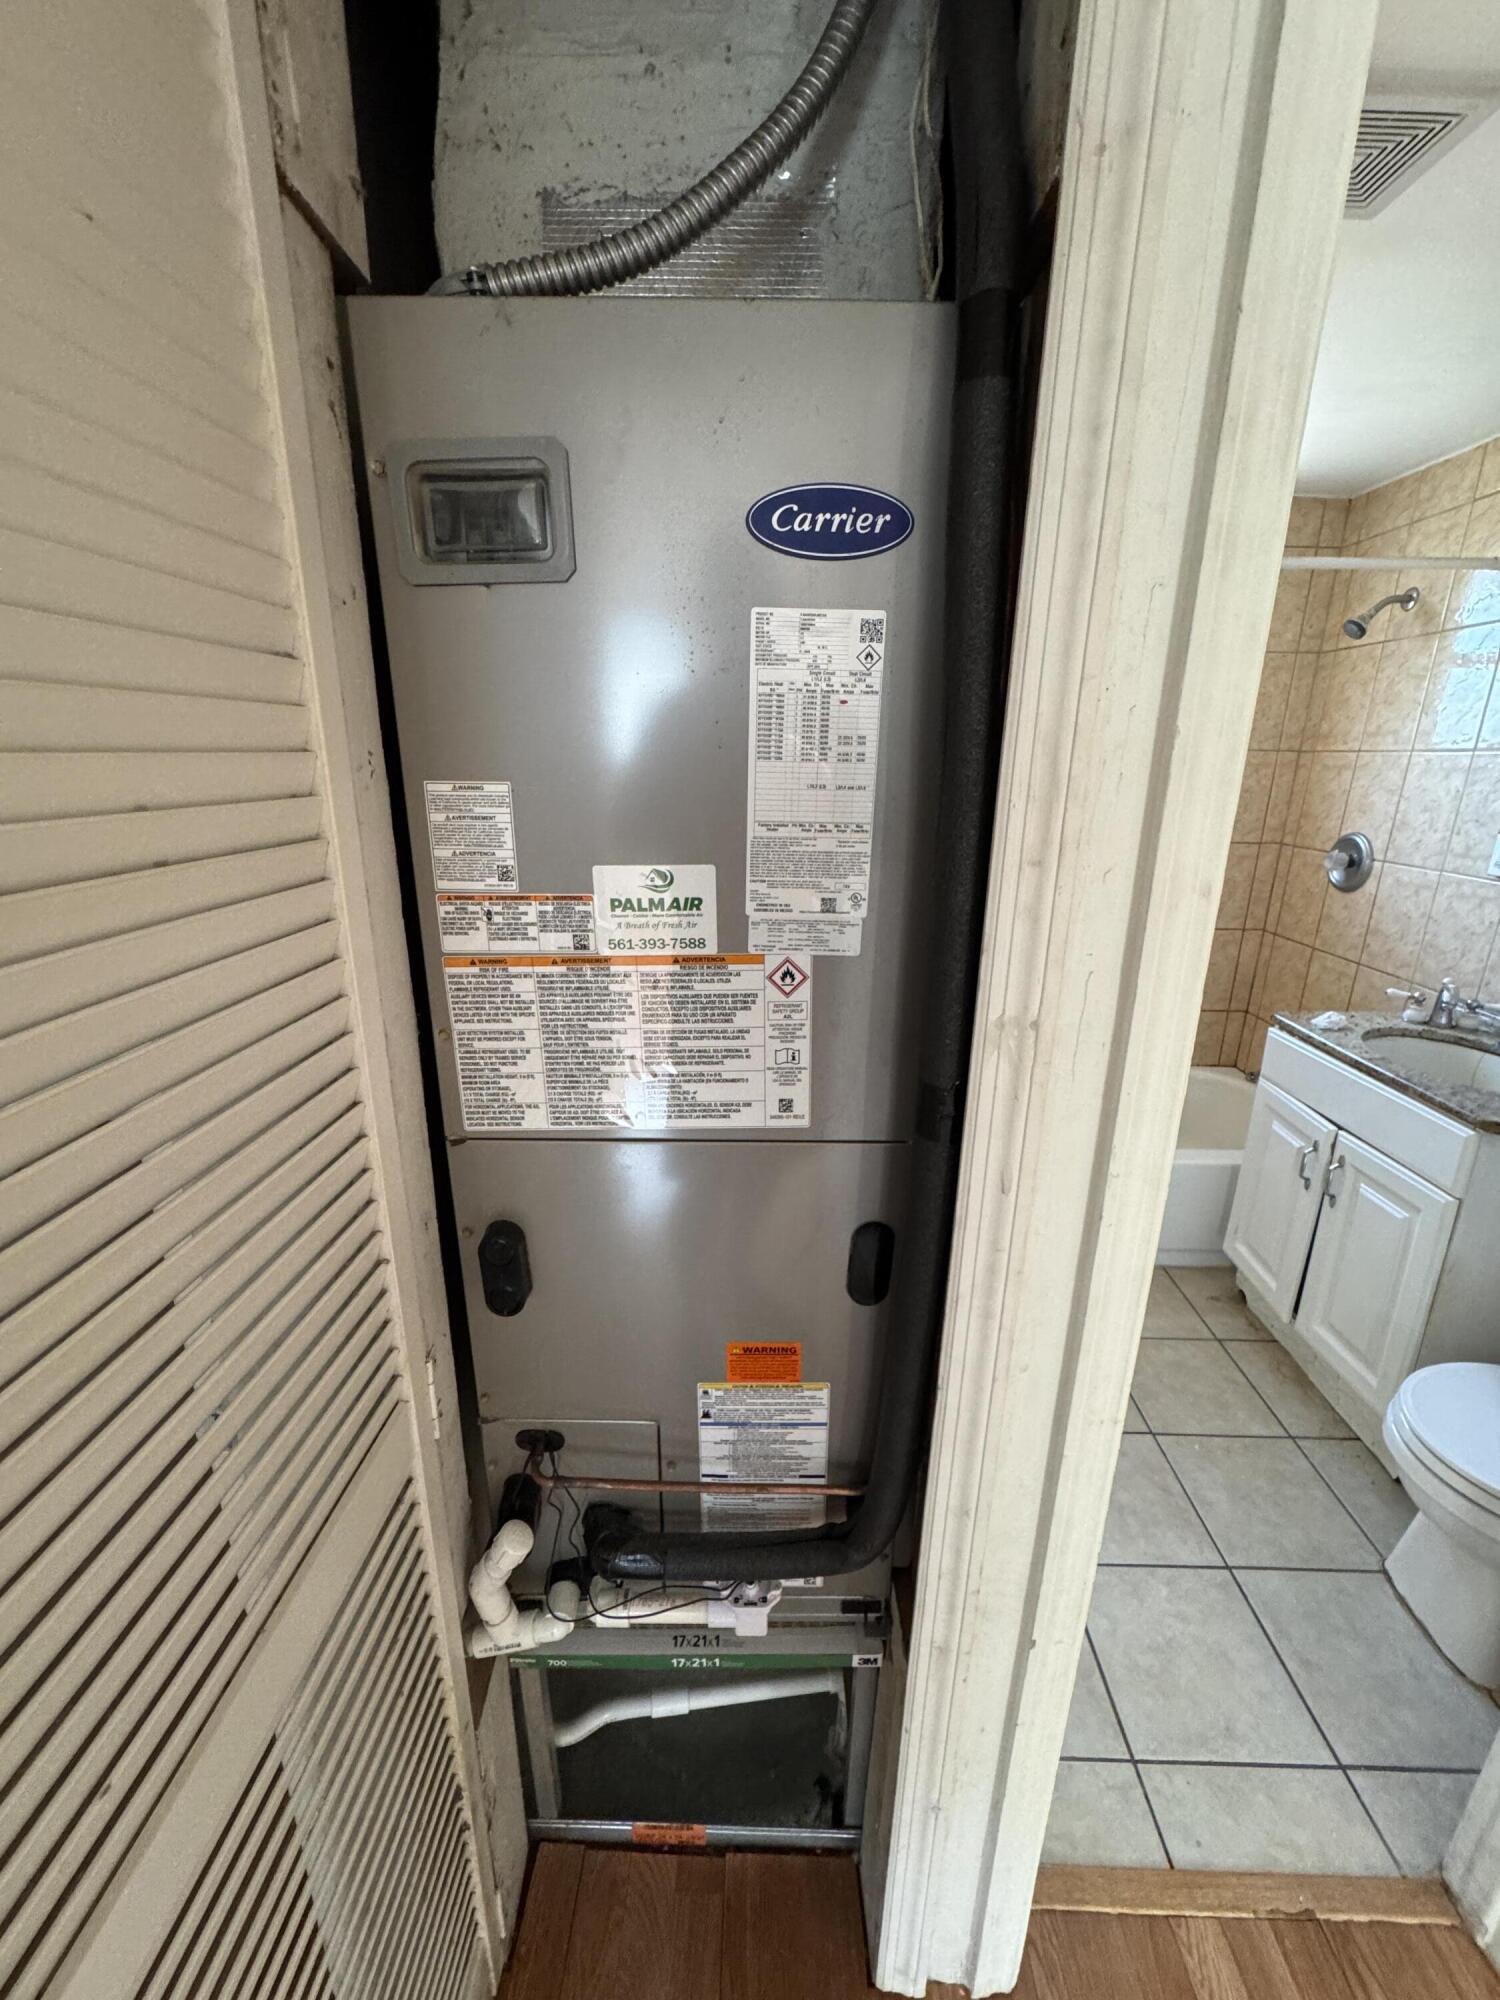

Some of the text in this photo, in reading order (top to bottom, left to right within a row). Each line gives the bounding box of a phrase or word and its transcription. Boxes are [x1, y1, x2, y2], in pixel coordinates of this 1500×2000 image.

[771, 504, 891, 533] Carrier
[624, 921, 650, 929] Breath
[652, 921, 659, 931] of
[662, 920, 682, 929] Fresh
[684, 921, 698, 929] Air
[608, 938, 706, 950] 561-393-7588
[672, 1635, 720, 1648] 17x21x1
[672, 1658, 720, 1667] 17x21x1
